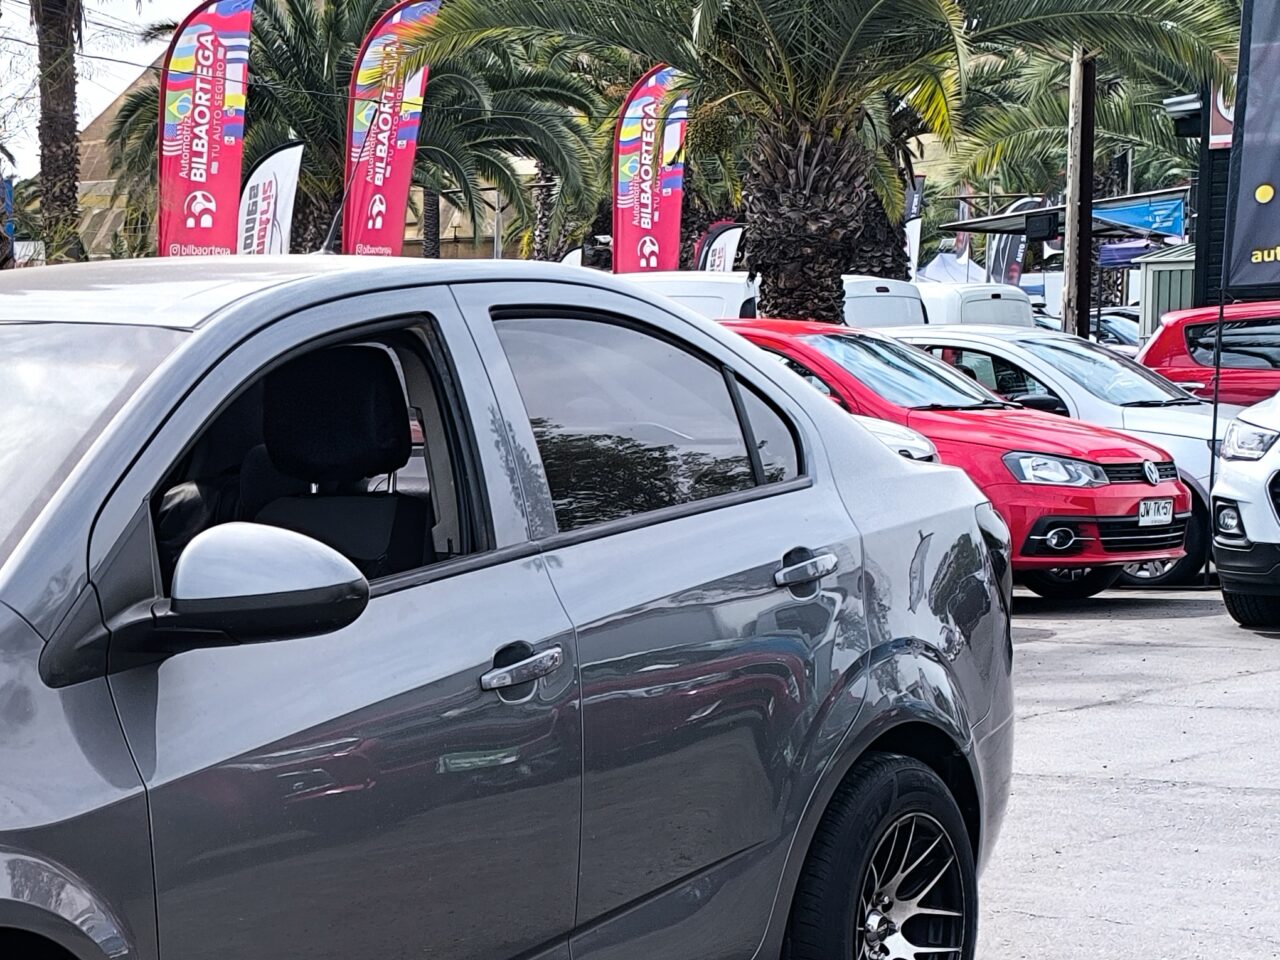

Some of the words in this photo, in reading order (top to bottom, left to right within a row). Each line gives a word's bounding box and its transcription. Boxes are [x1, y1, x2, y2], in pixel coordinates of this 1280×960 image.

[214, 60, 224, 106] SEGURO
[190, 33, 216, 183] BILBAORTEGA
[213, 109, 222, 141] AUTO
[179, 115, 192, 179] Automotriz
[211, 143, 219, 158] TU
[640, 101, 657, 230] BILBAORTEGA
[181, 244, 231, 256] bilbaortega
